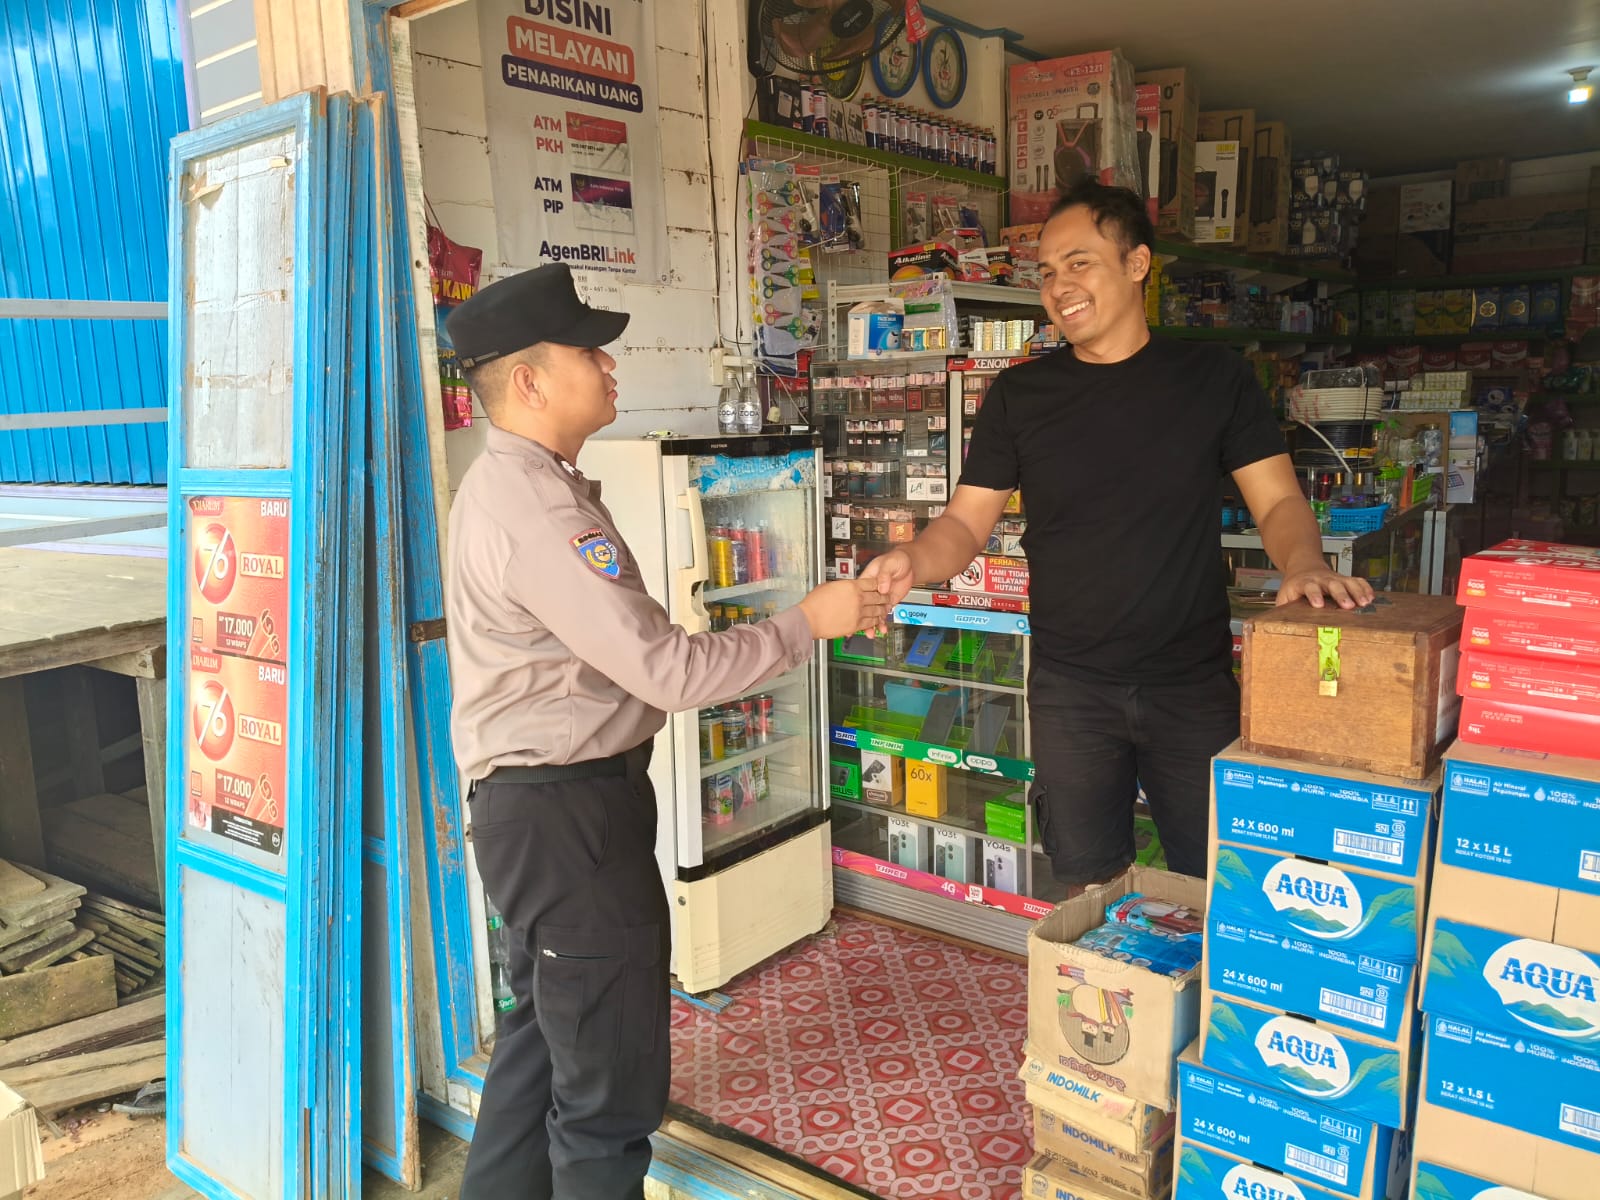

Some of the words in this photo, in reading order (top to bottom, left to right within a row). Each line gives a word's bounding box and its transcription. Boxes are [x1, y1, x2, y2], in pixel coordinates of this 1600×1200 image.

[525, 0, 611, 36] DISINI
[515, 26, 629, 75] MELAYANI
[507, 63, 597, 97] PENARIKAN
[599, 87, 639, 106] UANG
[534, 115, 562, 132] ATM
[536, 137, 564, 155] PKH
[534, 176, 562, 193] ATM
[544, 199, 564, 214] PIP
[539, 240, 636, 266] AgenBRILink
[895, 253, 932, 265] Alkaline
[973, 358, 1010, 369] XENON
[261, 501, 287, 517] BARU
[242, 557, 282, 575] ROYAL
[989, 569, 1007, 577] KAMI
[991, 576, 1027, 586] MELAYANI
[994, 584, 1024, 593] HUTANG
[957, 594, 992, 608] XENON
[908, 610, 927, 620] gopay
[954, 614, 990, 625] GOPAY
[225, 617, 253, 637] 17.000
[258, 666, 284, 686] BARU
[241, 722, 280, 742] ROYAL
[970, 755, 993, 768] oppo
[910, 768, 933, 782] 60x
[223, 776, 252, 799] 17.000
[1504, 782, 1527, 792] Mineral
[1550, 790, 1577, 800] 100%
[1329, 792, 1369, 804] INDONESIA
[1232, 817, 1245, 829] 24
[1257, 822, 1279, 834] 600
[1281, 827, 1295, 838] ml
[1456, 838, 1469, 849] 12
[1483, 843, 1500, 855] 1.5
[1504, 847, 1512, 857] L
[941, 882, 956, 895] 4G
[1275, 873, 1349, 909] AQUA
[1293, 940, 1313, 950] 100%
[1318, 951, 1356, 966] INDONESIA
[1223, 968, 1235, 979] 24
[1247, 975, 1267, 988] 600
[1270, 982, 1283, 993] ml
[1499, 957, 1597, 1003] AQUA
[1267, 1031, 1337, 1070] AQUA
[1046, 1071, 1101, 1103] INDOMILK
[1441, 1080, 1454, 1091] 12
[1457, 1085, 1464, 1093] x
[1468, 1087, 1483, 1100] 1.5
[1487, 1093, 1495, 1103] L
[1062, 1122, 1115, 1155] INDOMILK
[1193, 1117, 1206, 1129] 24
[1216, 1125, 1236, 1140] 600
[1238, 1134, 1250, 1145] ml
